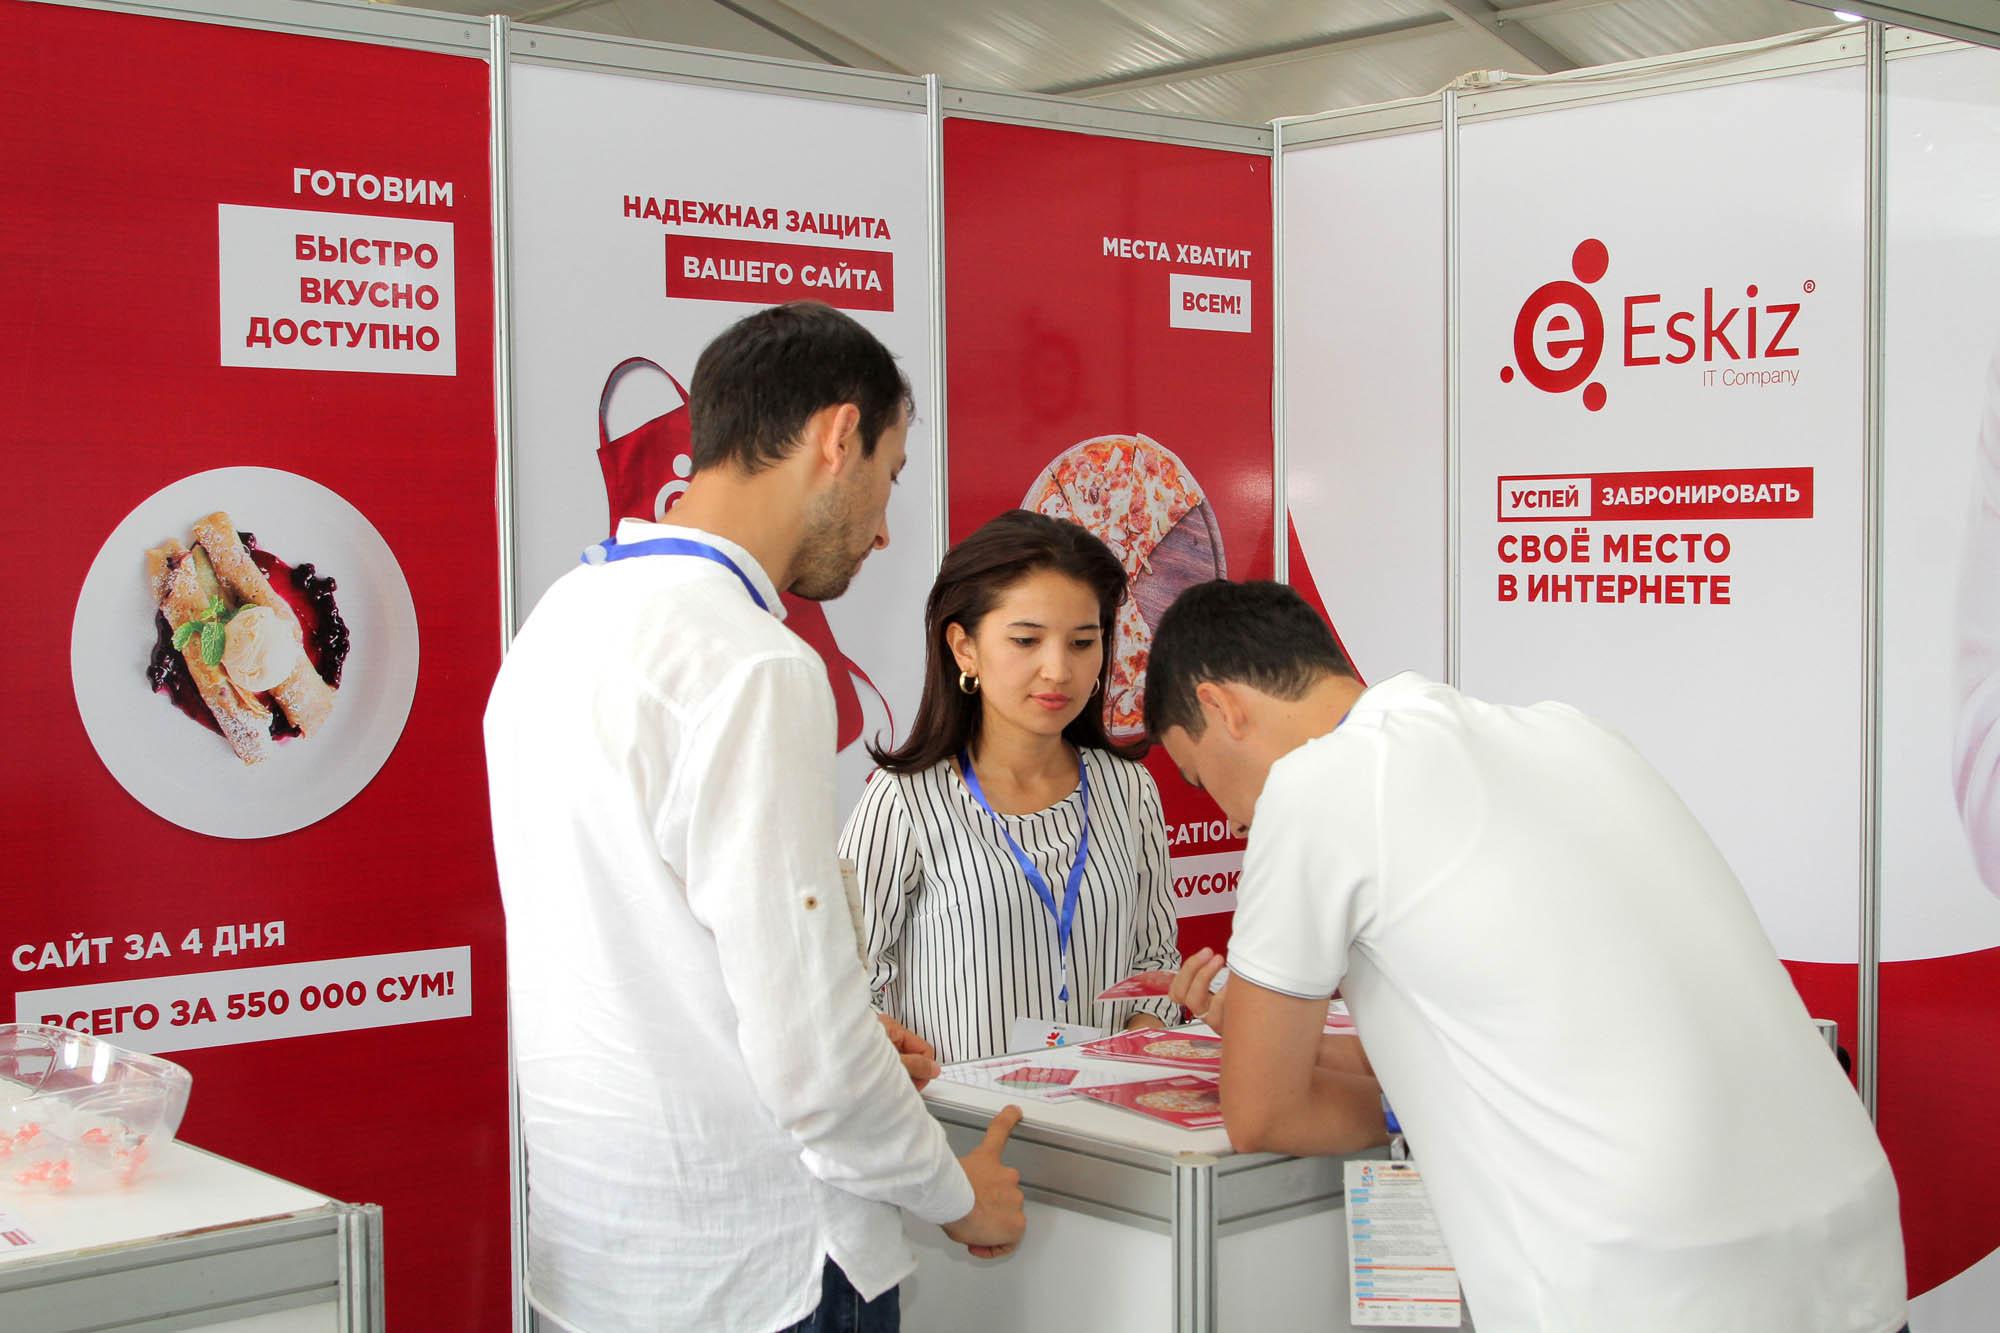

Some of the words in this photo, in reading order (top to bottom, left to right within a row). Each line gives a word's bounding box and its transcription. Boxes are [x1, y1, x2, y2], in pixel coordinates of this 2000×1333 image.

[293, 167, 454, 207] ГОТОВИМ
[623, 195, 779, 230] НАДЕЖНАЯ
[786, 210, 892, 240] ЗАЩИТА
[295, 234, 439, 270] БЫСТРО
[1103, 236, 1171, 262] МЕСТА
[1176, 243, 1252, 269] ХВАТИТ
[683, 255, 794, 285] ВАШЕГО
[800, 261, 883, 292] САЙТА
[300, 277, 440, 311] ВКУСНО
[1182, 291, 1241, 315] ВСЕМ!
[246, 316, 440, 352] ДОСТУПНО
[1624, 284, 1800, 367] Eskiz
[1703, 369, 1717, 387] IT
[1722, 368, 1800, 388] Company
[1511, 485, 1579, 508] УСПЕЙ
[1601, 483, 1800, 506] ЗАБРОНИРОВАТЬ
[1497, 527, 1590, 563] СВОЁ
[1603, 533, 1731, 563] МЕСТО
[1498, 574, 1518, 602] В
[1528, 574, 1731, 604] ИНТЕРНЕТЕ
[12, 933, 113, 972] САЙТ
[124, 932, 171, 960] ЗА
[181, 928, 203, 954] 4
[213, 920, 286, 957] ДНЯ
[170, 997, 217, 1027] ЗА
[226, 989, 289, 1020] 550
[300, 980, 367, 1011] 000
[376, 970, 455, 1001] СУМ!
